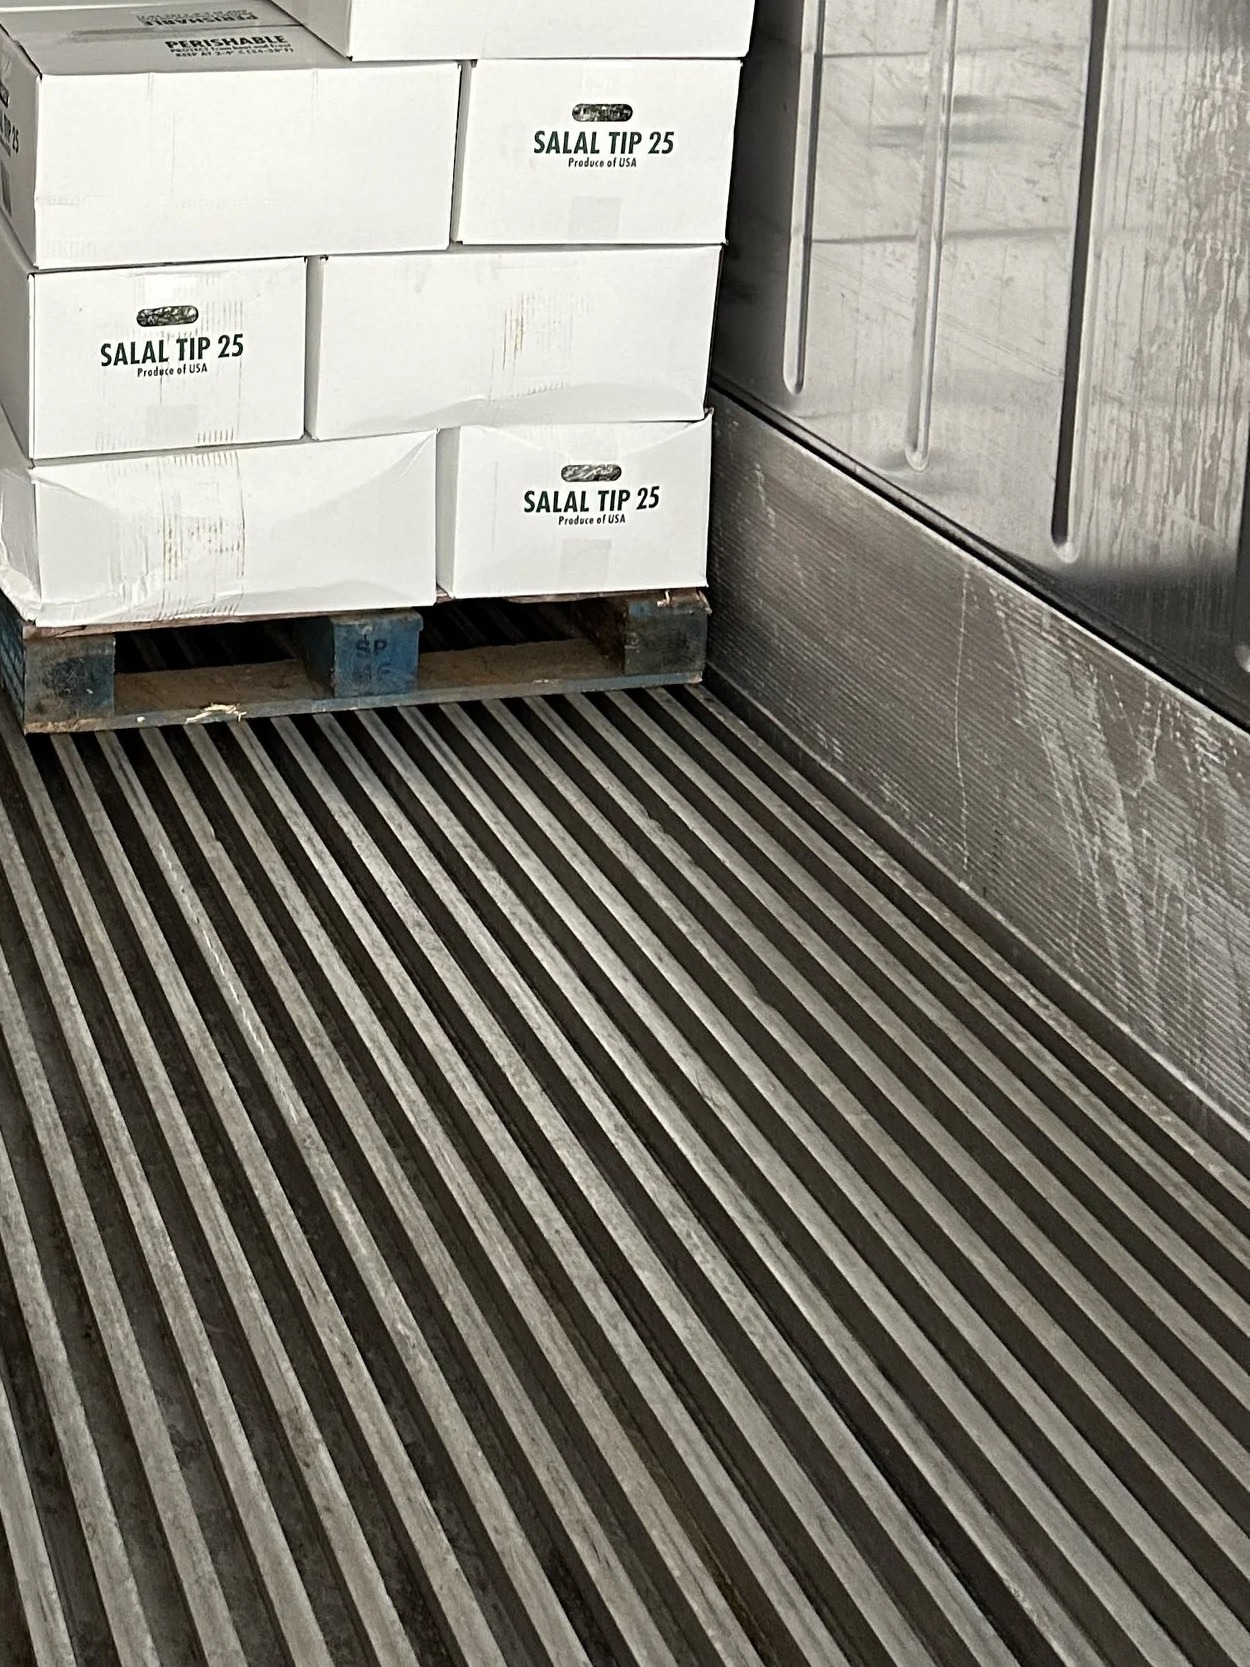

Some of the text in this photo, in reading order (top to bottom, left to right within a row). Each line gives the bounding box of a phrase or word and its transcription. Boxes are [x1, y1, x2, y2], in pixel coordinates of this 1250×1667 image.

[164, 35, 288, 49] PERISHABLE
[12, 124, 19, 154] 25
[533, 130, 675, 155] SALAL TIP 25
[568, 157, 637, 168] Produce of USA
[100, 333, 244, 367] SALAL TIP 25
[137, 362, 208, 378] Produce of USA
[524, 485, 660, 513] SALAL TIP 25
[558, 513, 626, 526] Produce of USA
